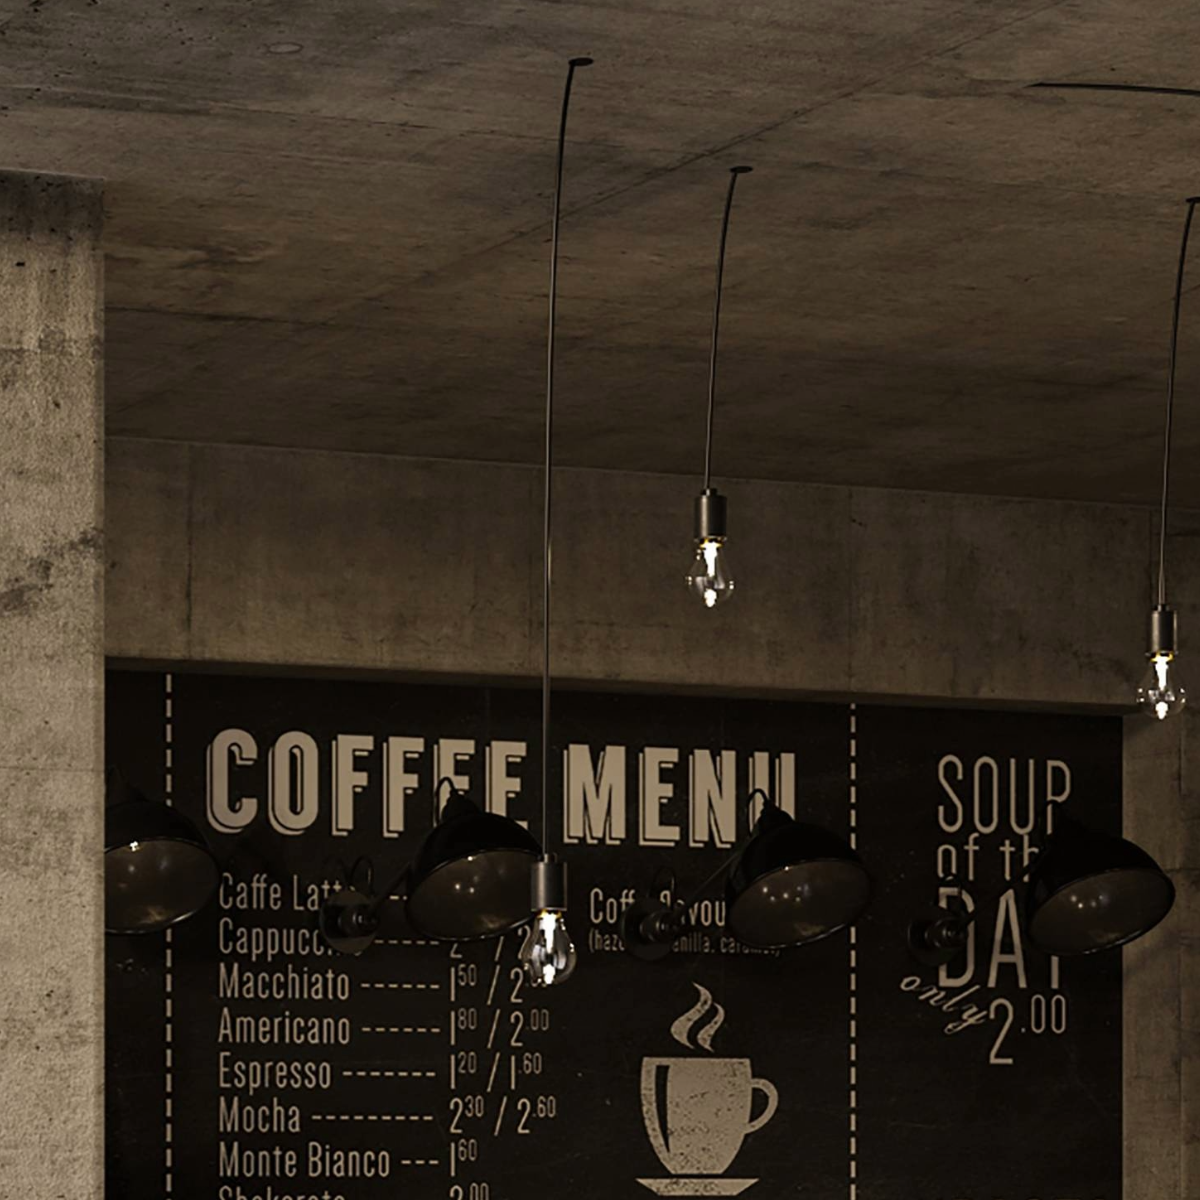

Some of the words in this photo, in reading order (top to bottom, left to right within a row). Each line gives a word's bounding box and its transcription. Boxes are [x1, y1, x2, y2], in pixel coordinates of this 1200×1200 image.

[563, 744, 796, 848] MENU
[938, 754, 1071, 835] SOUP
[938, 832, 980, 883] of
[219, 872, 282, 911] Caffe
[938, 886, 1059, 990] DA
[218, 962, 350, 1000] Macchiato
[218, 1007, 350, 1045] Americano
[900, 974, 988, 1035] only
[989, 994, 1067, 1065] 2.00
[218, 1051, 332, 1096] Espresso
[218, 1096, 301, 1133] Mocha
[218, 1141, 297, 1178] Monte
[308, 1141, 390, 1178] Bianco
